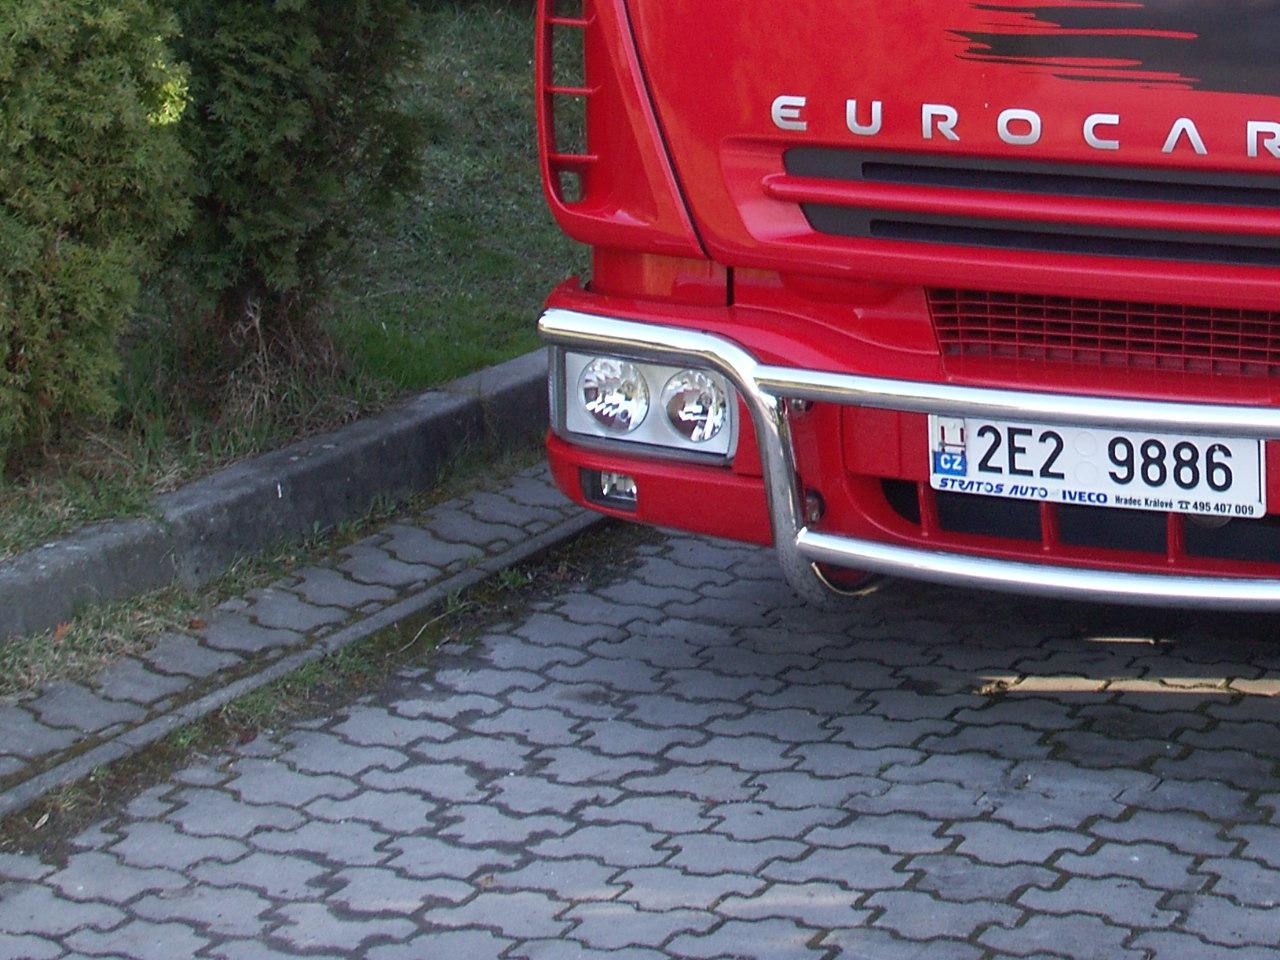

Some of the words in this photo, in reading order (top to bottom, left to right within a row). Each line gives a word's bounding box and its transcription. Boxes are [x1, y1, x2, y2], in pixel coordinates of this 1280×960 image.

[940, 453, 964, 470] CZ
[976, 424, 1066, 480] 2E2
[1107, 436, 1233, 492] 9886
[938, 477, 1004, 494] STRATOS
[1009, 484, 1048, 498] AUTO
[1062, 490, 1108, 504] IVECO
[1114, 495, 1142, 507] Hradec
[1144, 497, 1174, 509] Králové
[1192, 501, 1211, 512] 495
[1213, 503, 1232, 514] 407
[1234, 505, 1254, 515] 009
